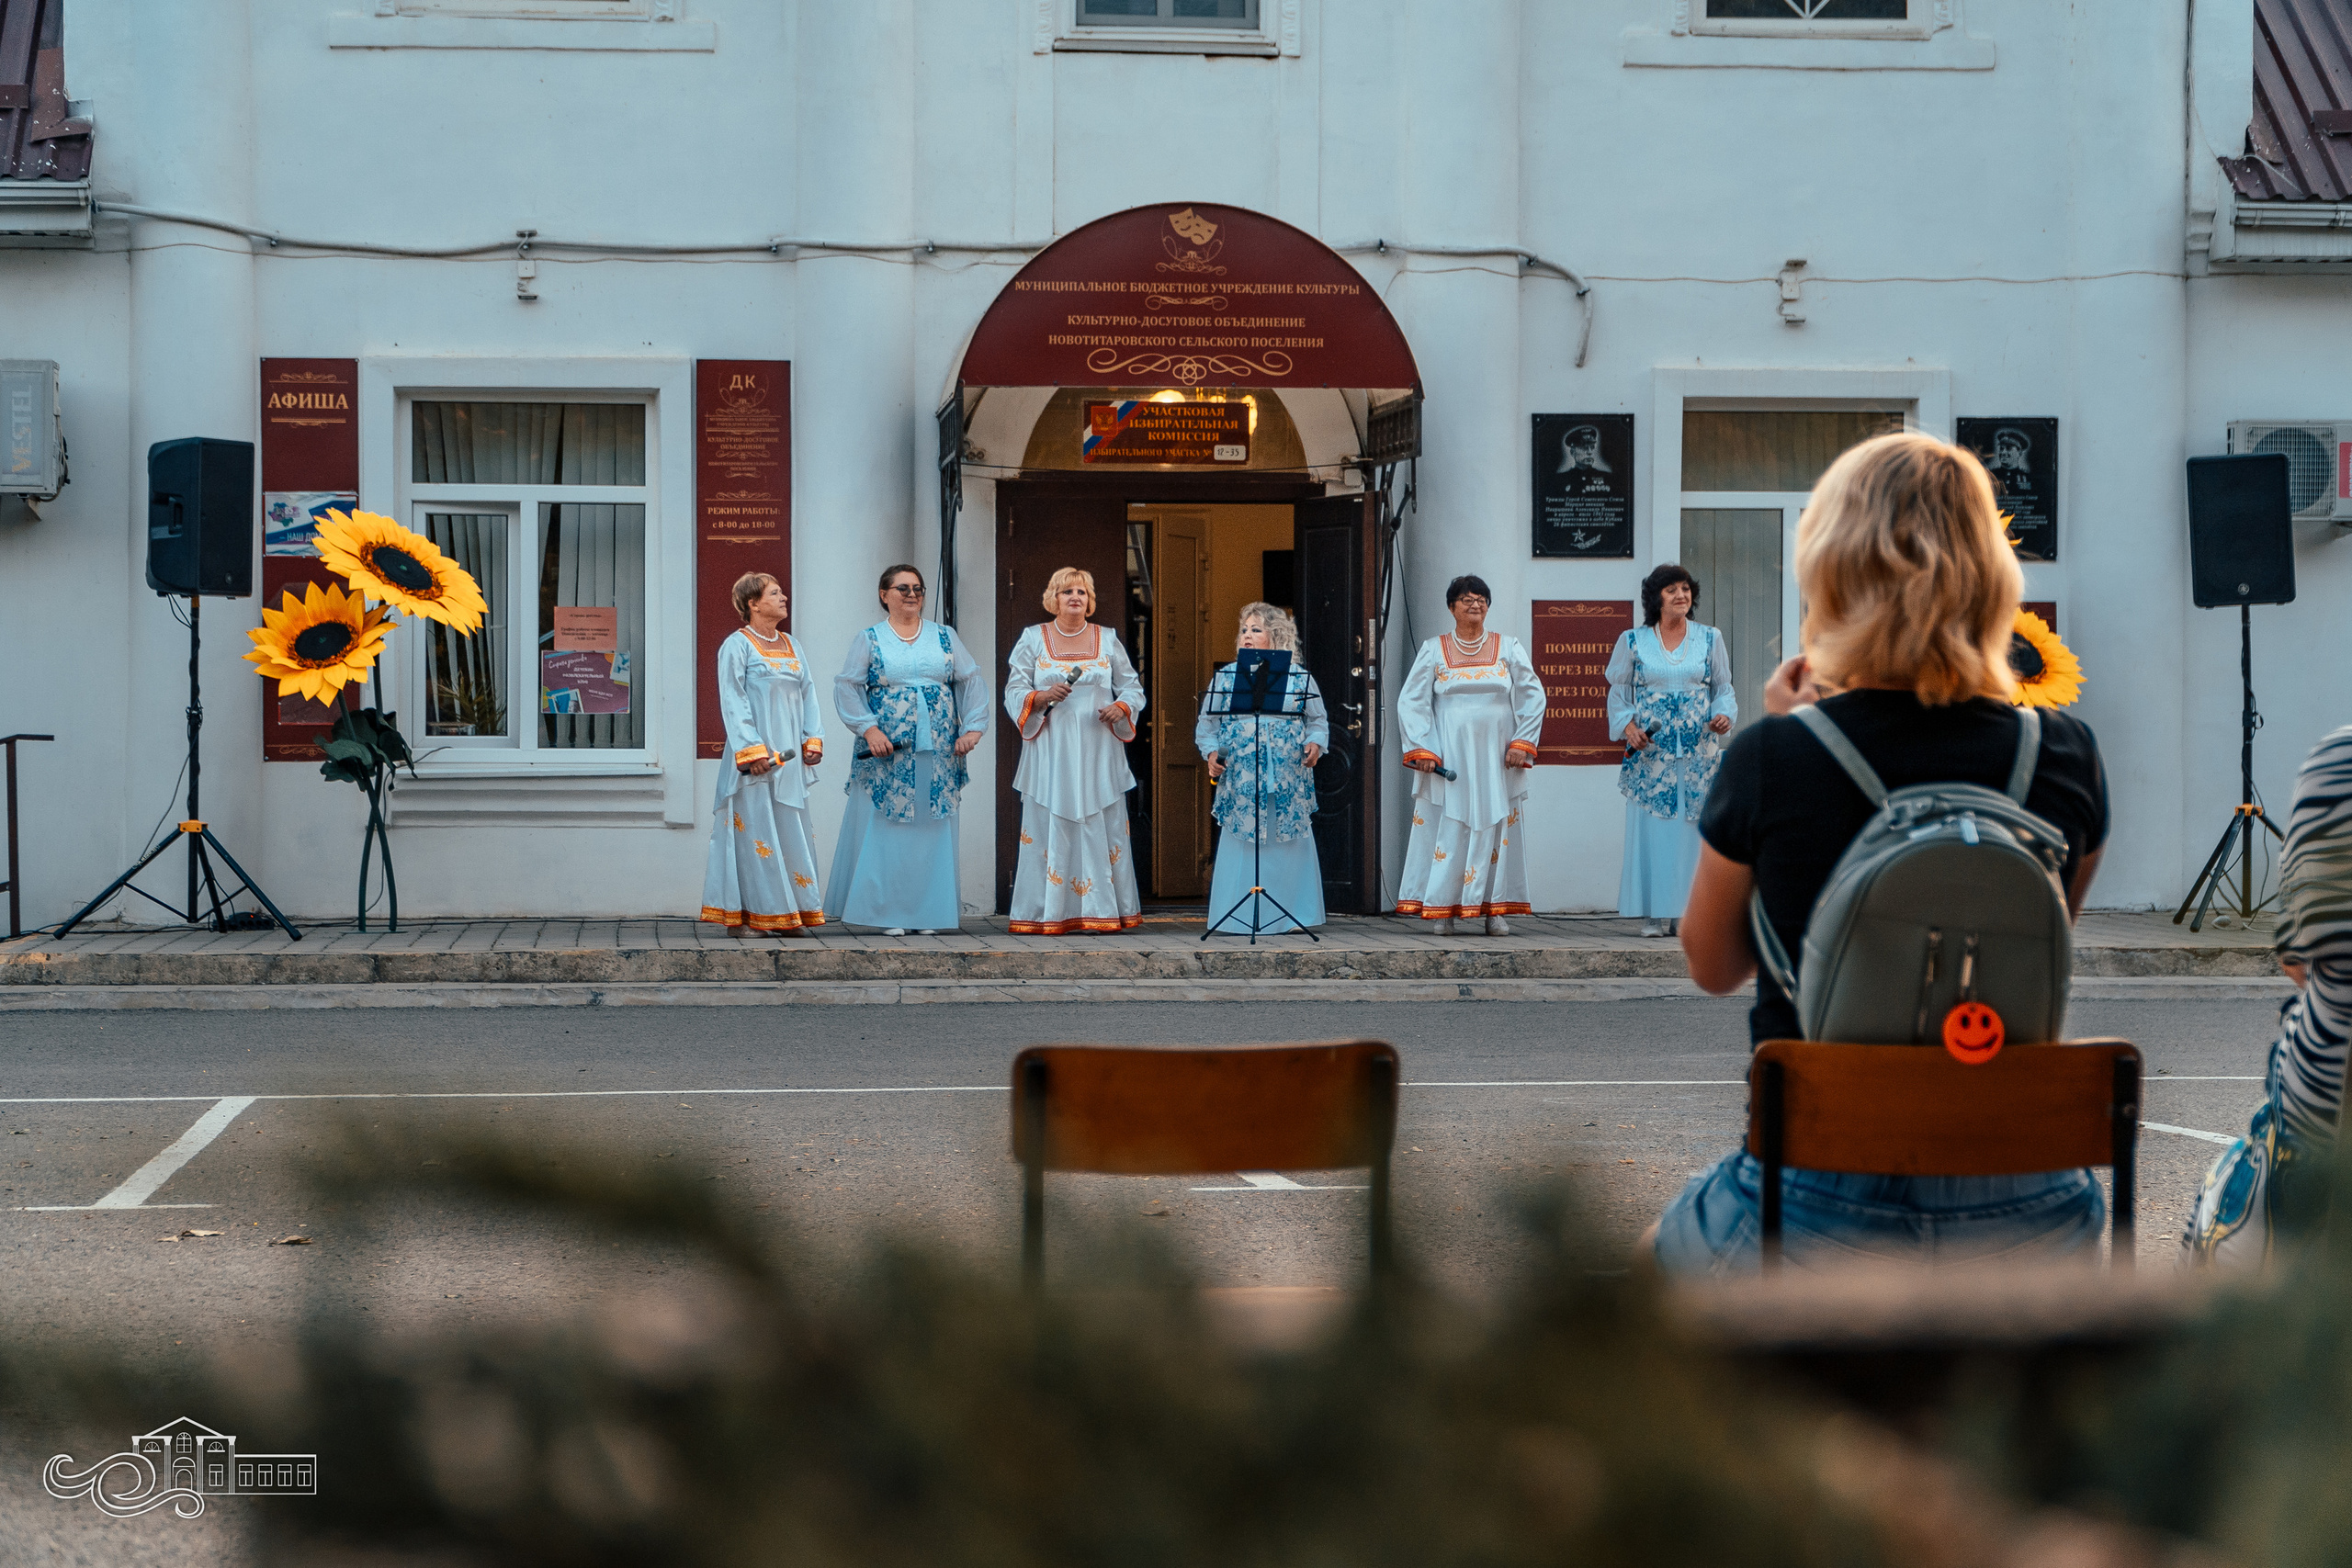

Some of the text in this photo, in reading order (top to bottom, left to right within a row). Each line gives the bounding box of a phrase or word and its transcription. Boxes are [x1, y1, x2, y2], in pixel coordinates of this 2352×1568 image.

[1015, 280, 1360, 296] МУНИЦИПАЛЬНОЕ БЮДЖЕТНОЕ УЧРЕЖДЕНИЕ КУЛЬТУРЫ
[1068, 315, 1306, 329] КУЛЬТУРНО-ДОСУГОВОЕ ОБЪЕДИНЕНИЕ
[1048, 334, 1324, 348] НОВОТИТАРОВСКОГО СЕЛЬСКОГО ПОСЕЛЕНИЯ
[729, 375, 756, 390] ДК
[267, 392, 349, 410] АФИША
[1142, 407, 1226, 418] УЧАСТКОВАЯ
[11, 384, 32, 473] VESTEL
[1129, 419, 1238, 430] ИЗБИРАТЕЛЬНАЯ
[1148, 431, 1220, 442] КОМИССИЯ
[1090, 447, 1163, 457] ИЗБИРАТЕЛЬНОГО
[1165, 448, 1201, 457] УЧАСТКА
[707, 507, 741, 515] РЕЖИМ
[287, 532, 304, 541] НАШ
[1545, 643, 1613, 654] ПОМНИТЕ
[1540, 664, 1606, 675] ЧЕРЕЗ ВЕ
[1544, 686, 1607, 698] ЕРЕЗ ГОД
[1545, 707, 1609, 718] ПОМНИТ
